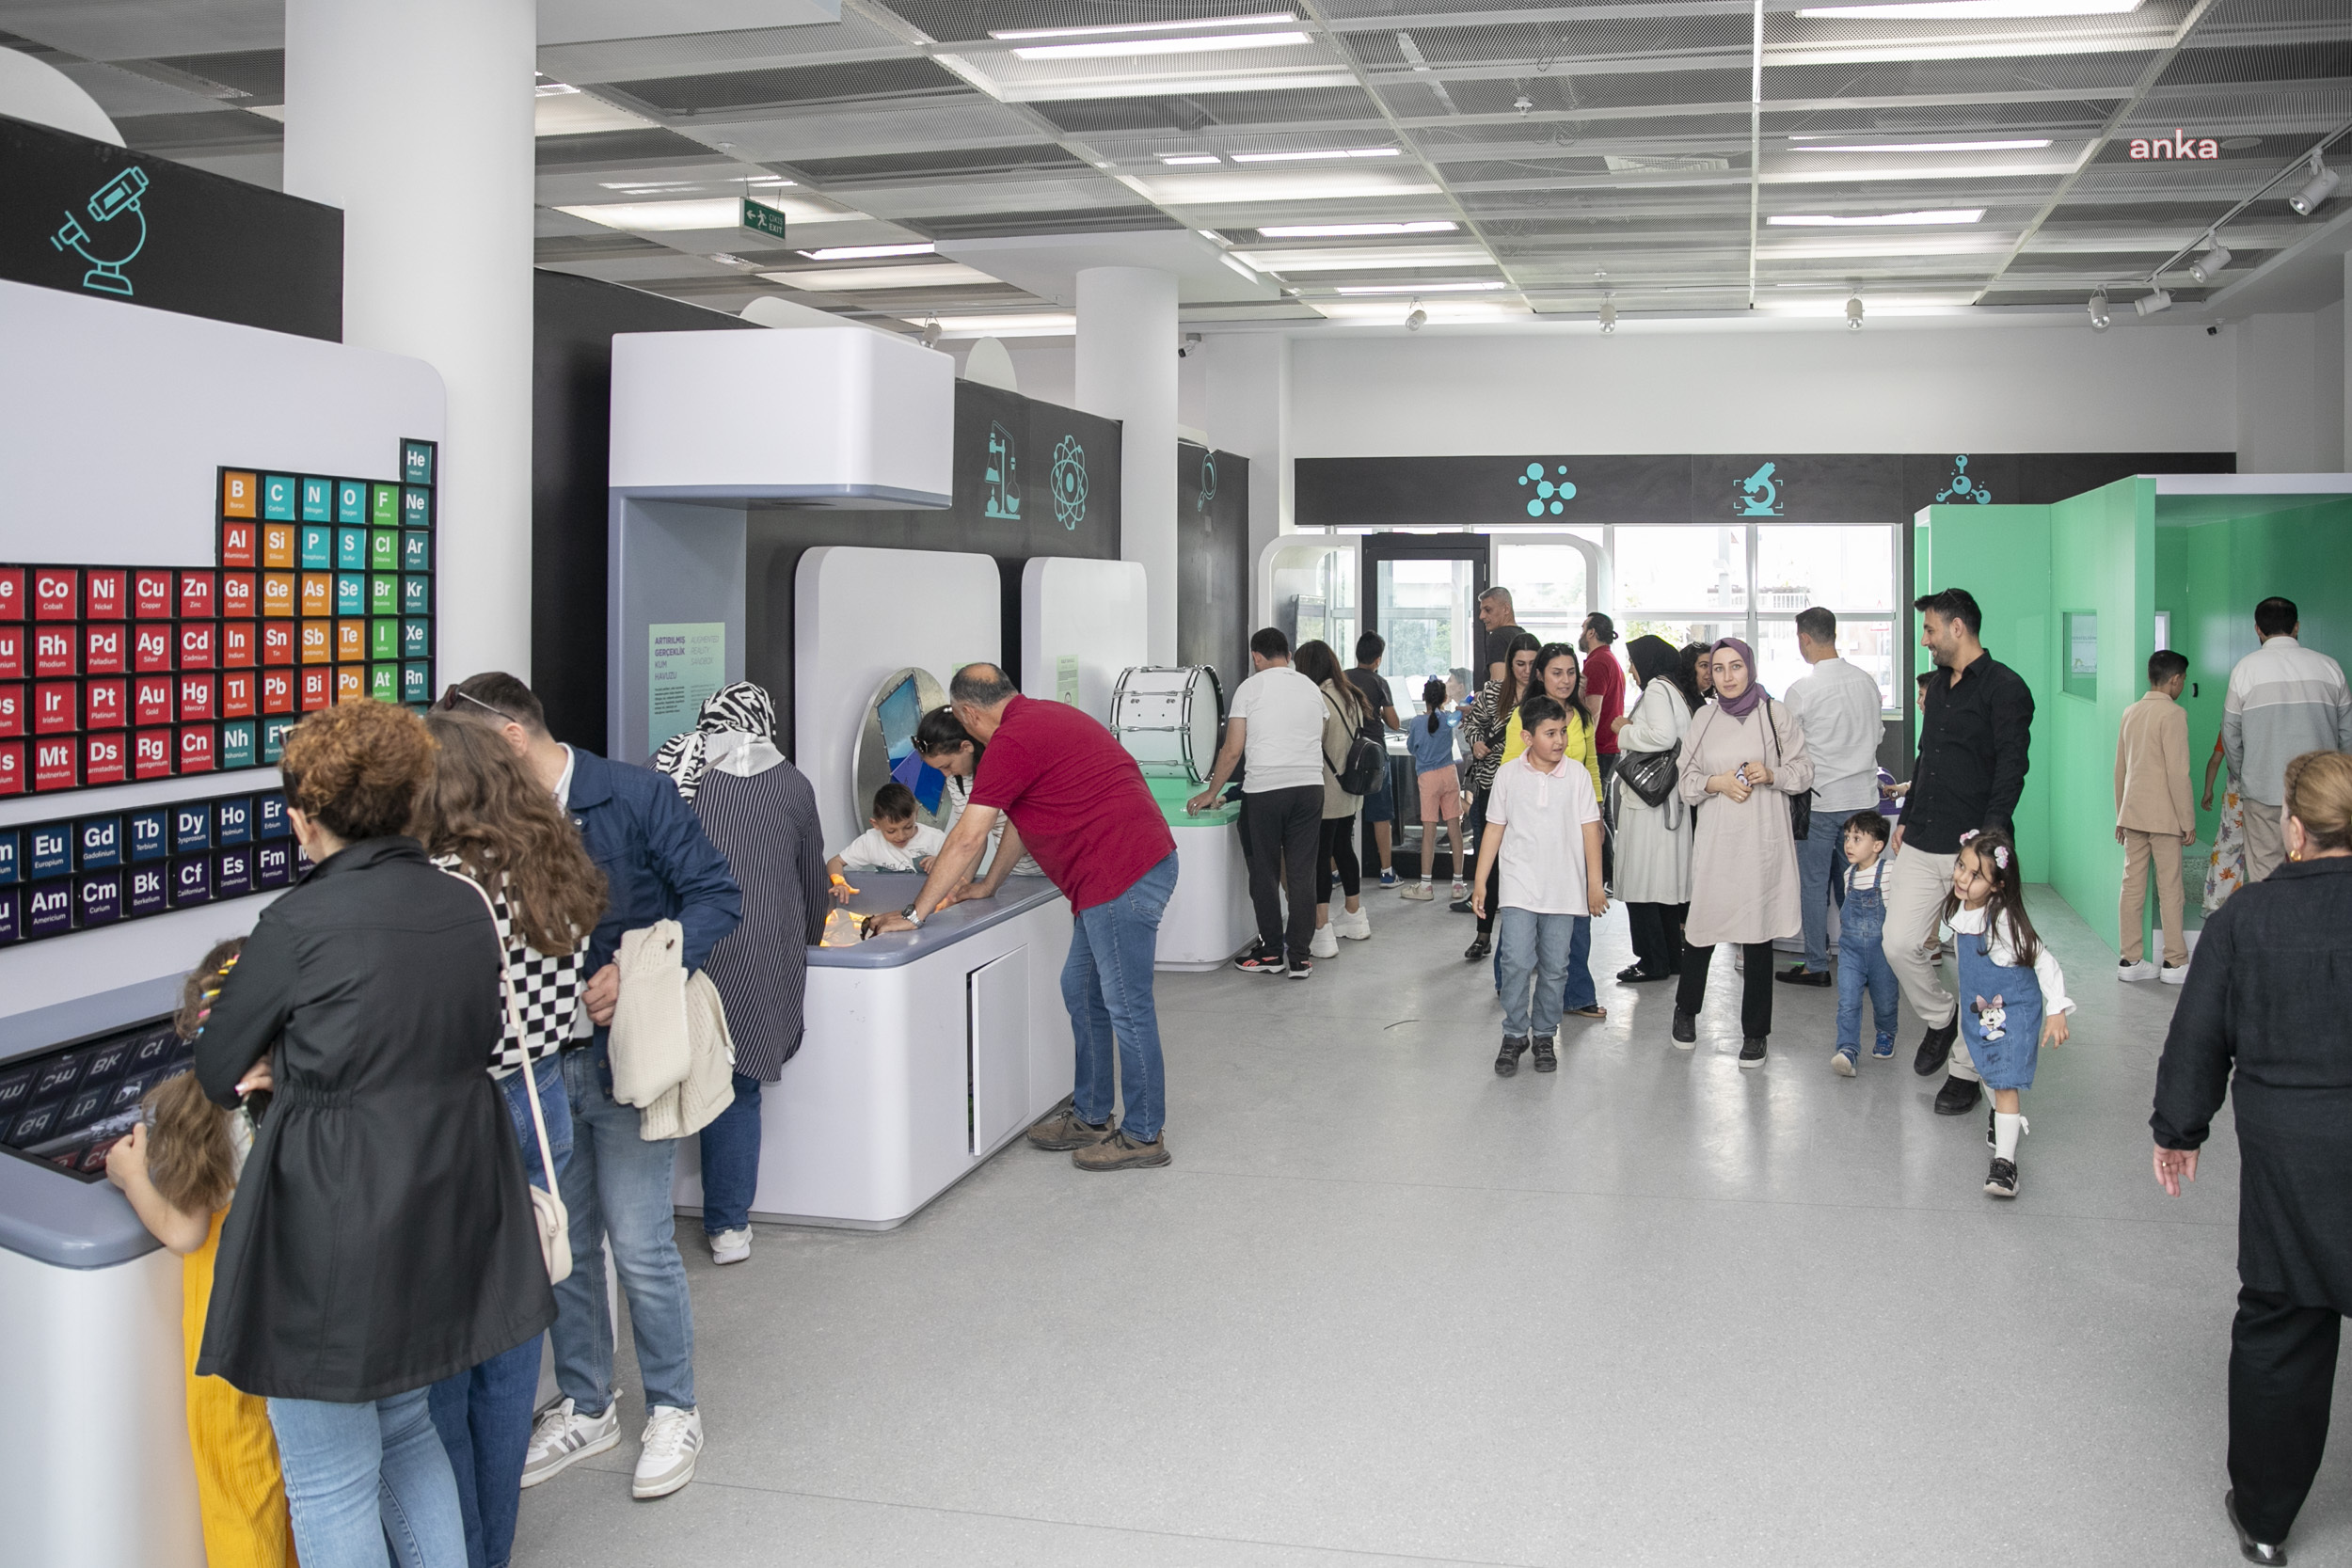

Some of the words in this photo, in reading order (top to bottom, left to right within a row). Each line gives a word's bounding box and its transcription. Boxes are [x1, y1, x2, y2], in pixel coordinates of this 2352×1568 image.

[769, 224, 783, 234] EXIT
[407, 451, 425, 467] He
[232, 480, 244, 498] B
[271, 484, 283, 501] C
[309, 486, 321, 503] N
[344, 489, 356, 505] O
[379, 492, 388, 507] F
[406, 494, 424, 510] Ne
[228, 530, 246, 548] Al
[269, 531, 285, 549] Si
[309, 533, 319, 549] P
[344, 535, 355, 551] S
[376, 537, 389, 553] Cl
[407, 538, 423, 554] Ar
[0, 580, 13, 597] e
[39, 578, 69, 598] Co
[93, 578, 115, 598] Ni
[138, 578, 165, 597] Cu
[183, 578, 207, 597] Zn
[225, 579, 248, 597] Ga
[265, 580, 288, 597] Ge
[304, 580, 325, 597] As
[339, 580, 358, 596] Se
[374, 581, 390, 596] Br
[407, 581, 422, 597] Kr
[183, 631, 208, 650] Cd
[229, 630, 245, 648] In
[266, 629, 287, 646] Sn
[303, 628, 324, 645] Sb
[341, 626, 358, 643] Te
[380, 626, 384, 641] I
[405, 626, 423, 641] Xe
[0, 640, 14, 656] u
[39, 635, 67, 656] Rh
[90, 632, 117, 654] Pd
[137, 633, 165, 656] Ag
[307, 675, 322, 693] Bi
[339, 673, 358, 690] Po
[374, 672, 390, 688] At
[405, 670, 423, 686] Rn
[655, 672, 677, 680] HAVUZU
[138, 686, 165, 705] Au
[183, 682, 208, 705] Hg
[228, 680, 244, 699] Tl
[265, 678, 286, 696] Pb
[45, 691, 62, 711] Ir
[93, 688, 116, 707] Pt
[0, 698, 15, 715] s
[183, 734, 207, 752] Cn
[225, 729, 248, 748] Nh
[40, 746, 68, 768] Mt
[90, 742, 118, 762] Ds
[138, 738, 163, 760] Rg
[0, 754, 15, 770] s
[87, 764, 123, 774] armstadtium
[136, 760, 167, 769] oentgenium
[37, 770, 71, 781] Meitnerium
[221, 807, 245, 826] Ho
[264, 801, 281, 819] Er
[134, 818, 159, 839] Tb
[179, 814, 203, 834] Dy
[222, 828, 244, 837] Holmium
[85, 825, 114, 847] Gd
[0, 844, 13, 862] m
[36, 835, 63, 856] Eu
[136, 842, 157, 851] Terbium
[298, 845, 310, 862] M
[35, 858, 64, 869] Europium
[83, 849, 115, 861] Gadolinium
[260, 849, 284, 868] Fm
[182, 863, 202, 884] Cf
[223, 858, 244, 876] Es
[262, 869, 282, 878] Fermium
[83, 880, 117, 903] Cm
[135, 872, 160, 894] Bk
[31, 891, 67, 913] Am
[134, 895, 160, 906] Berkelium
[0, 902, 9, 919] u
[89, 905, 110, 914] Curium
[33, 912, 66, 925] Americium
